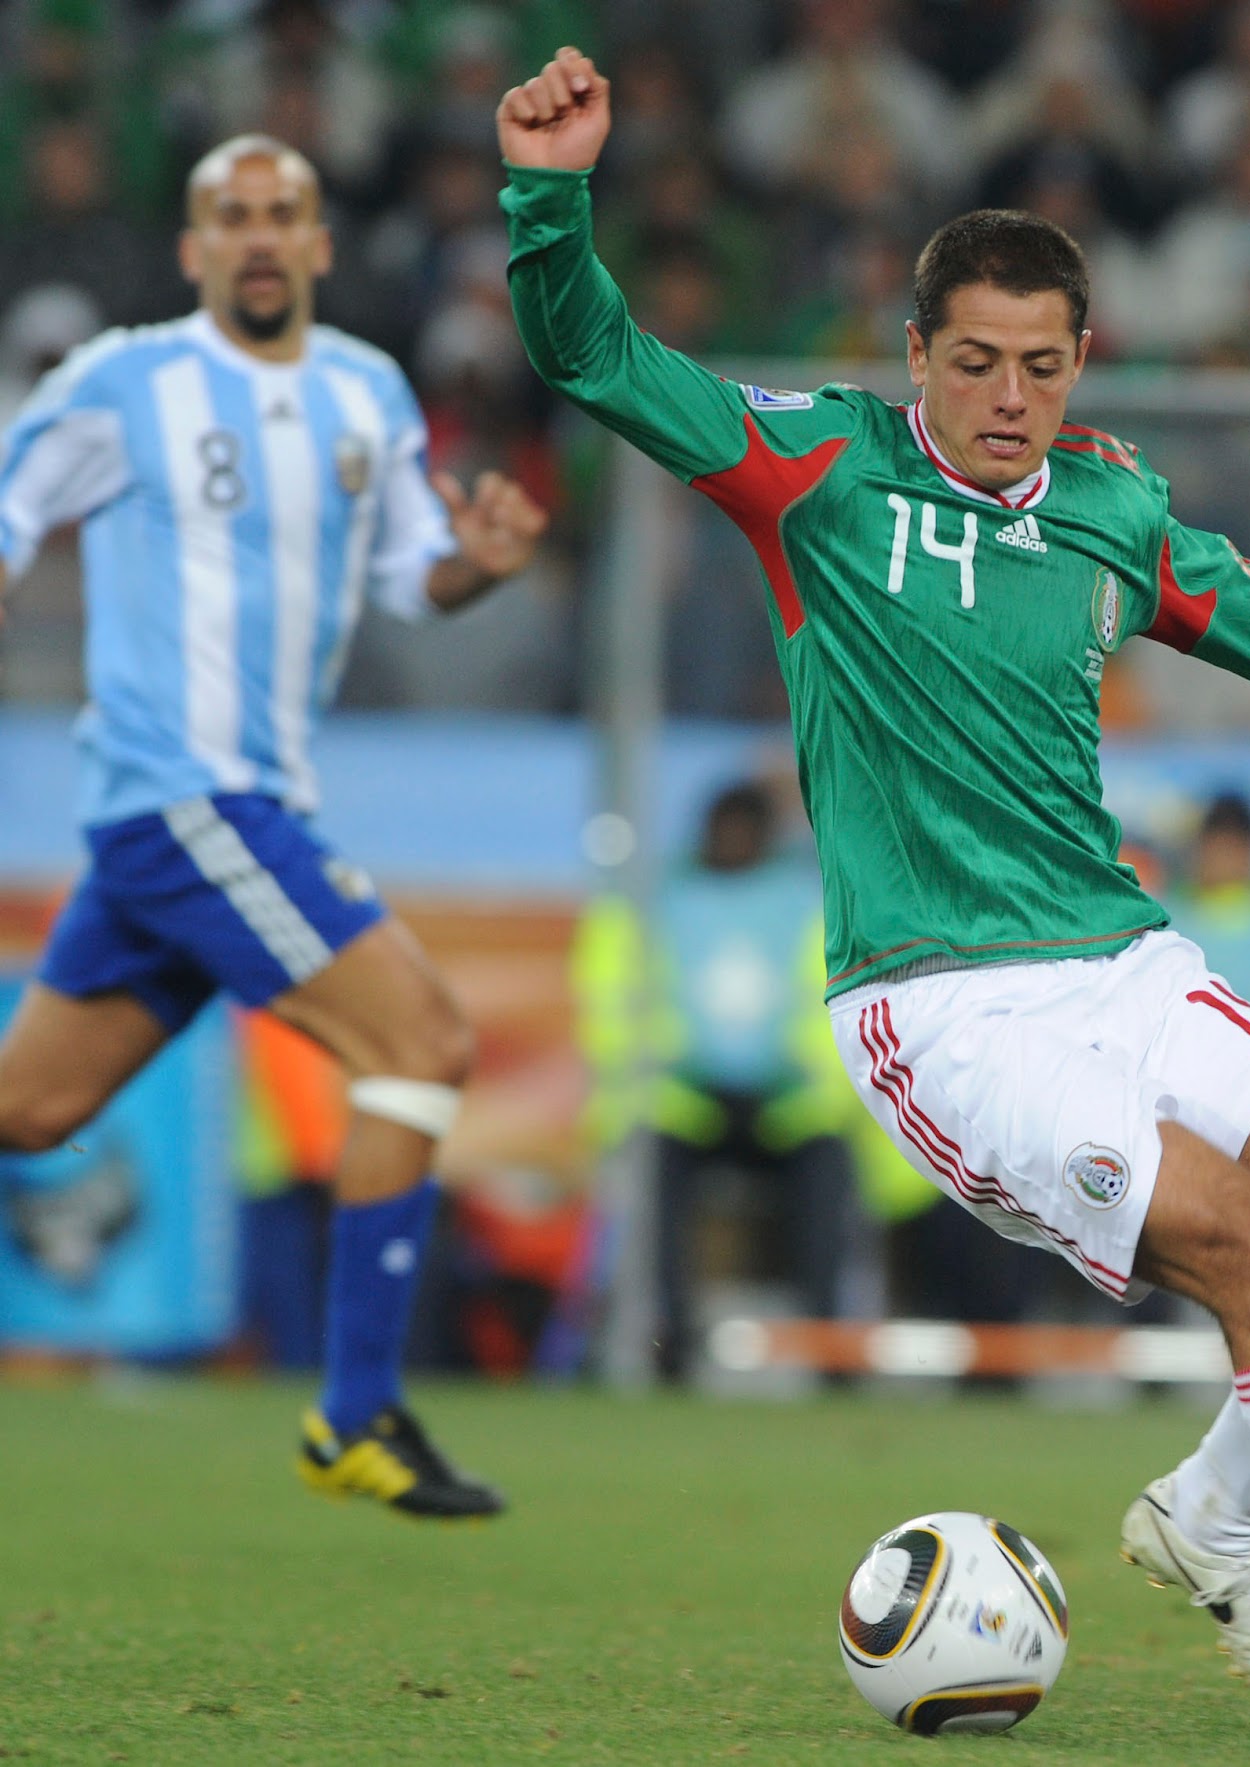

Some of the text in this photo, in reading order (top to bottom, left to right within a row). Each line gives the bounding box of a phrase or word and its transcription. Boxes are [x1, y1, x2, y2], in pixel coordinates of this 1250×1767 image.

[198, 430, 246, 510] 8
[887, 493, 979, 609] 14
[995, 531, 1048, 553] adidas
